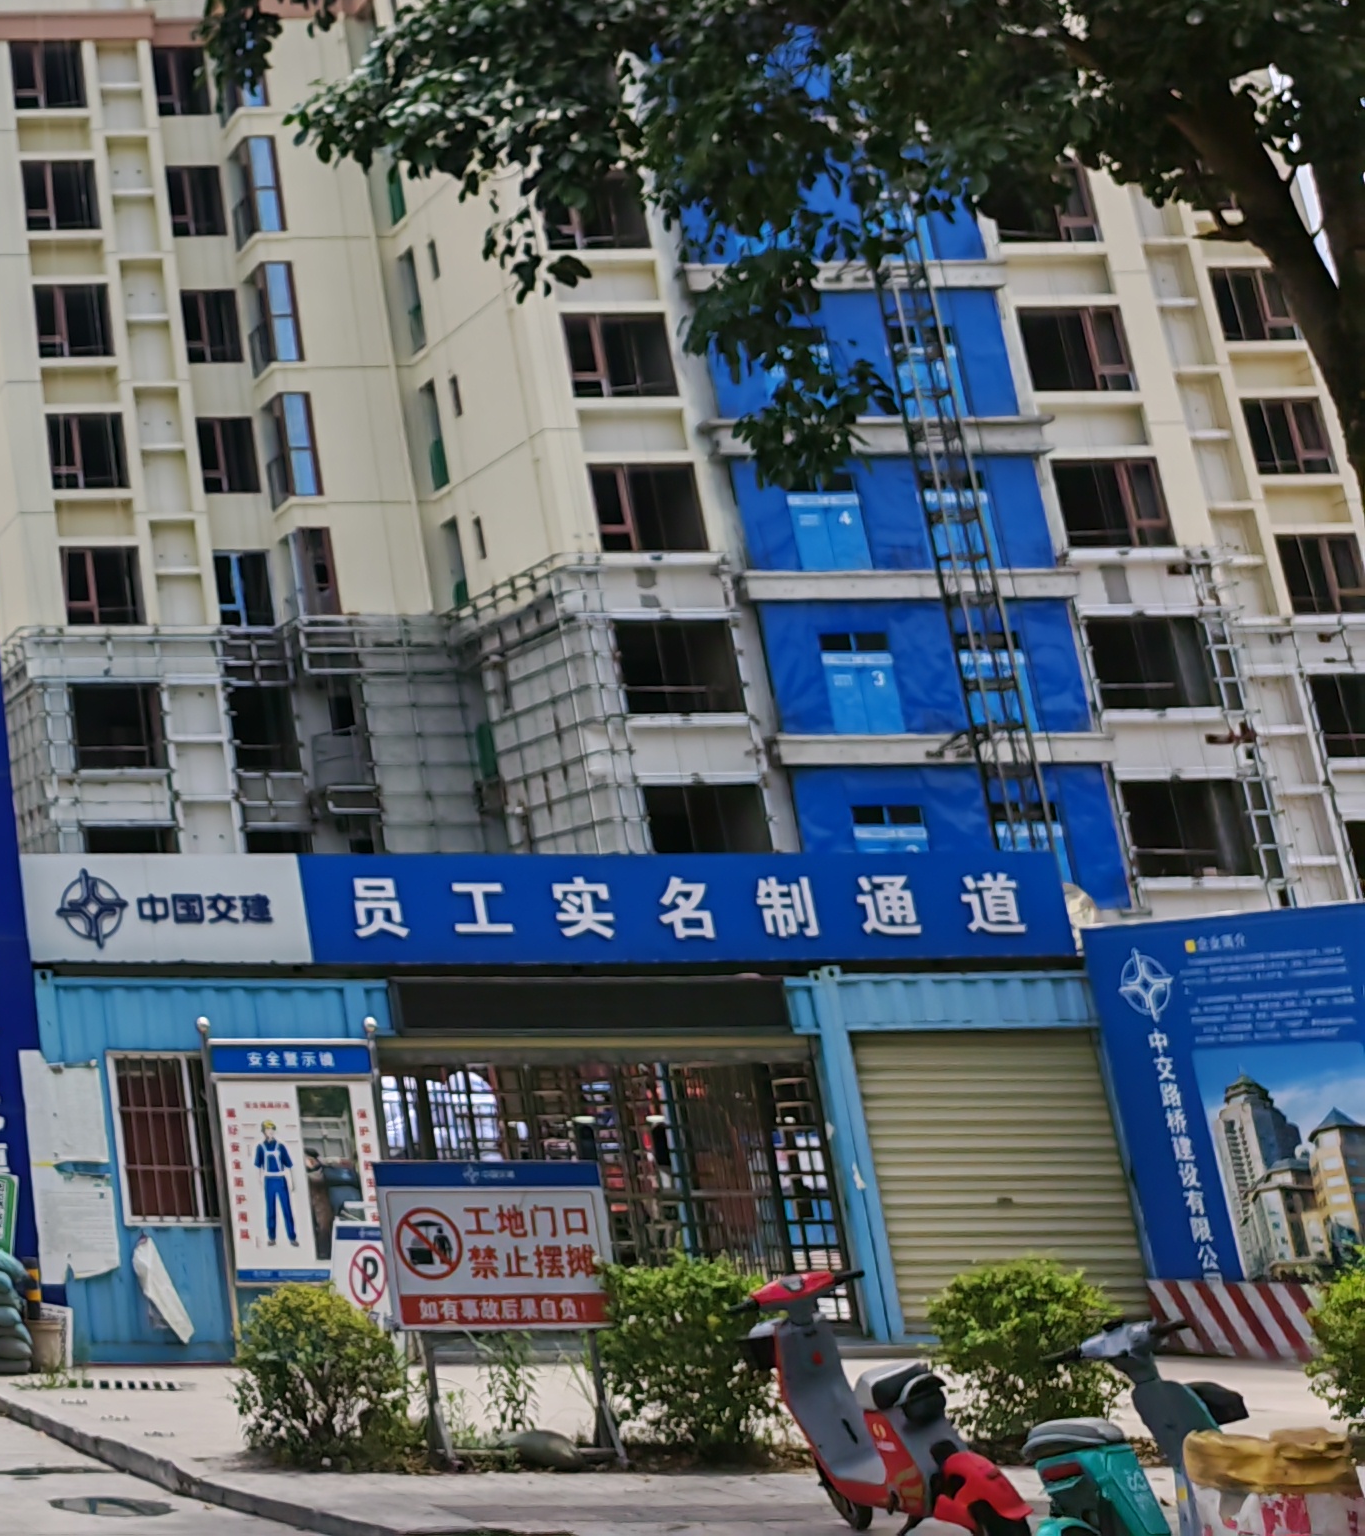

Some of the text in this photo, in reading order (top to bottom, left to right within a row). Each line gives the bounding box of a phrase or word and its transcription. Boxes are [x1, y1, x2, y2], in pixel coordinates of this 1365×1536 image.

[838, 510, 852, 525] 4
[871, 670, 884, 686] 3
[137, 892, 273, 925] 中国交建
[352, 873, 1027, 939] 员工实名制通道
[463, 1203, 589, 1238] 工地门口
[467, 1243, 597, 1280] 禁止摆摊
